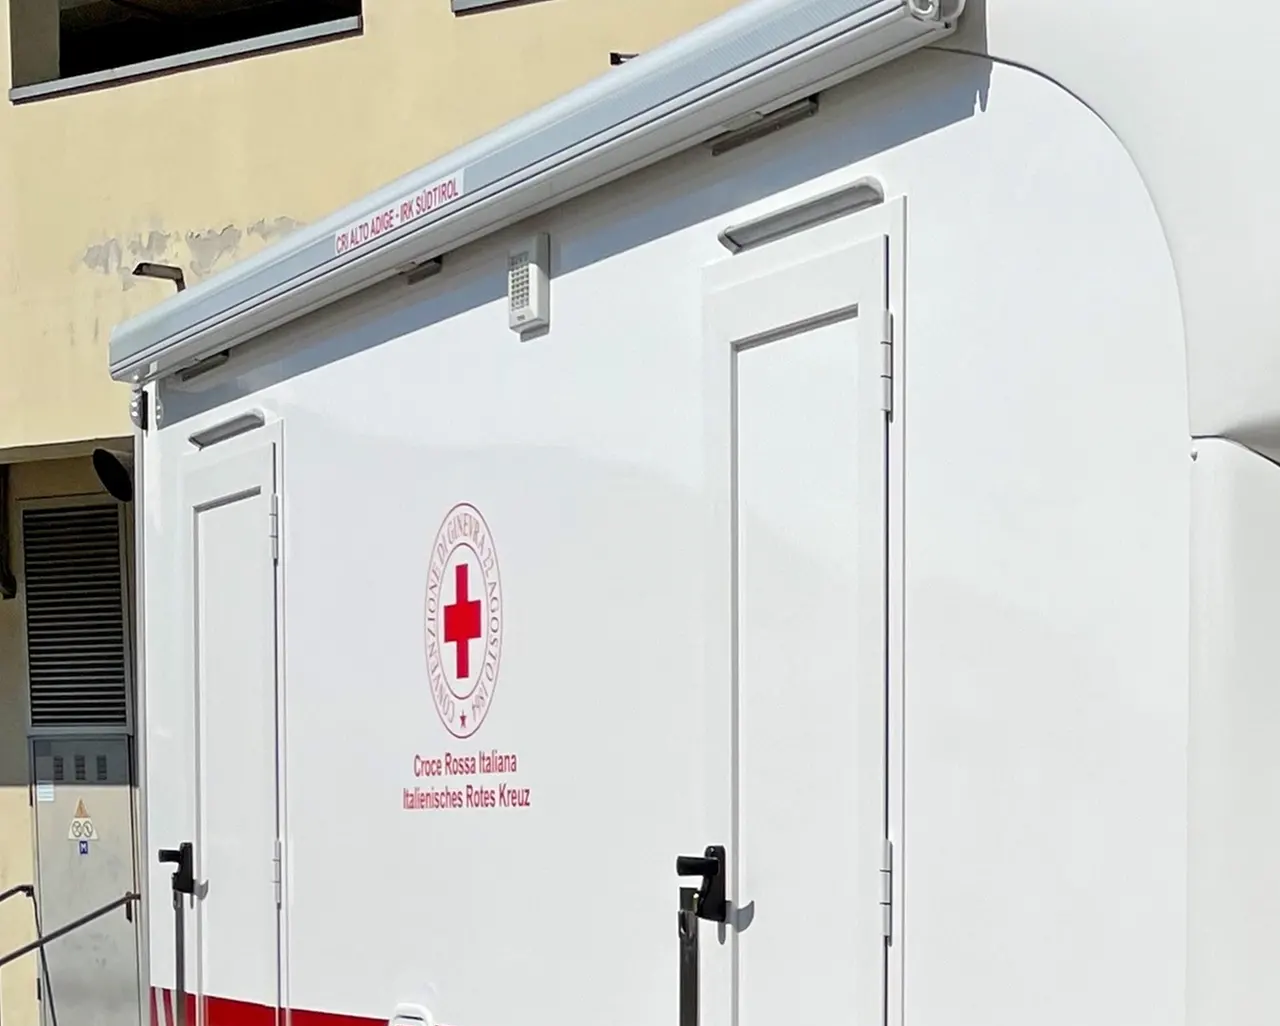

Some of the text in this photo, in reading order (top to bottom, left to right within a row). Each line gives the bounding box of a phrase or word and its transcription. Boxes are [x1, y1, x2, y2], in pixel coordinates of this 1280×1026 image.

[336, 232, 349, 254] CRI
[349, 222, 369, 248] ALTO
[370, 209, 394, 237] ADIGE
[400, 199, 414, 223] IRK
[415, 177, 458, 215] SÜDTIROL
[414, 750, 516, 777] Croce Rossa Italiana
[403, 783, 530, 809] Italienisches Rotes Kreuz
